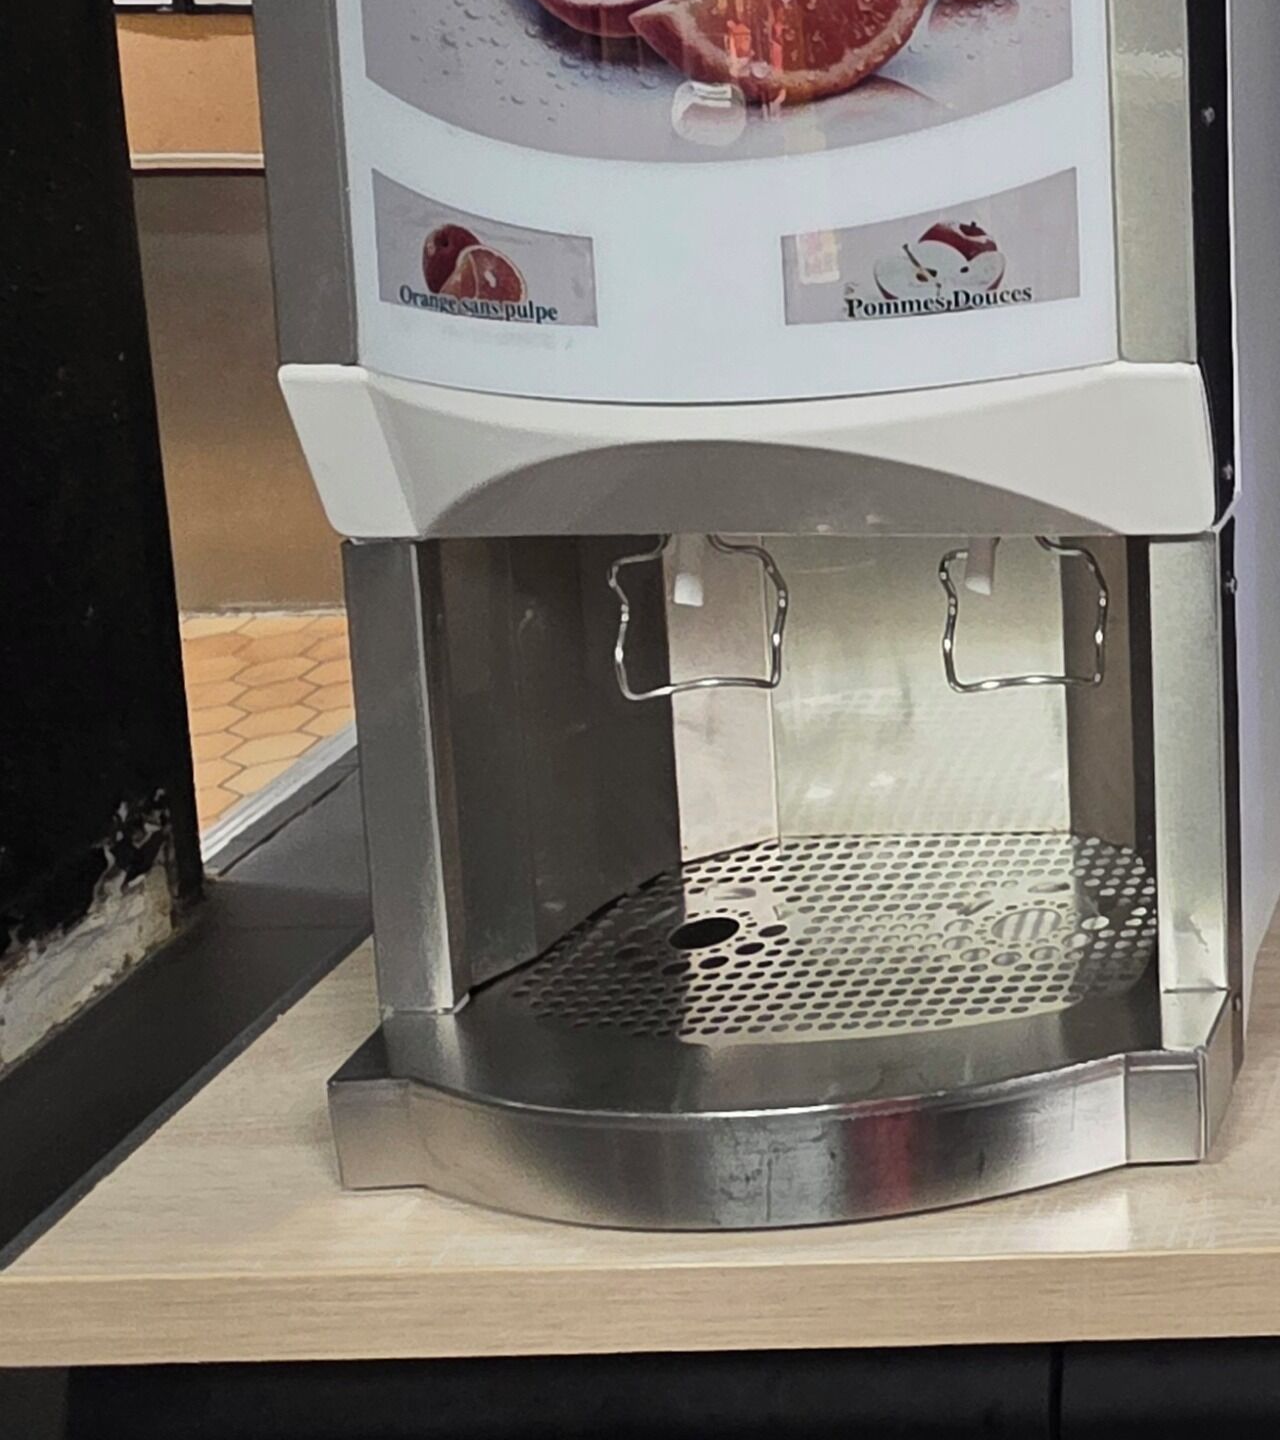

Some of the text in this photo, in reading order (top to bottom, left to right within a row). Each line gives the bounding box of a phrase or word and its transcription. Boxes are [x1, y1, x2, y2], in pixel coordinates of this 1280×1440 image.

[399, 285, 558, 324] Orange sans pulpe
[952, 287, 1032, 308] Douces
